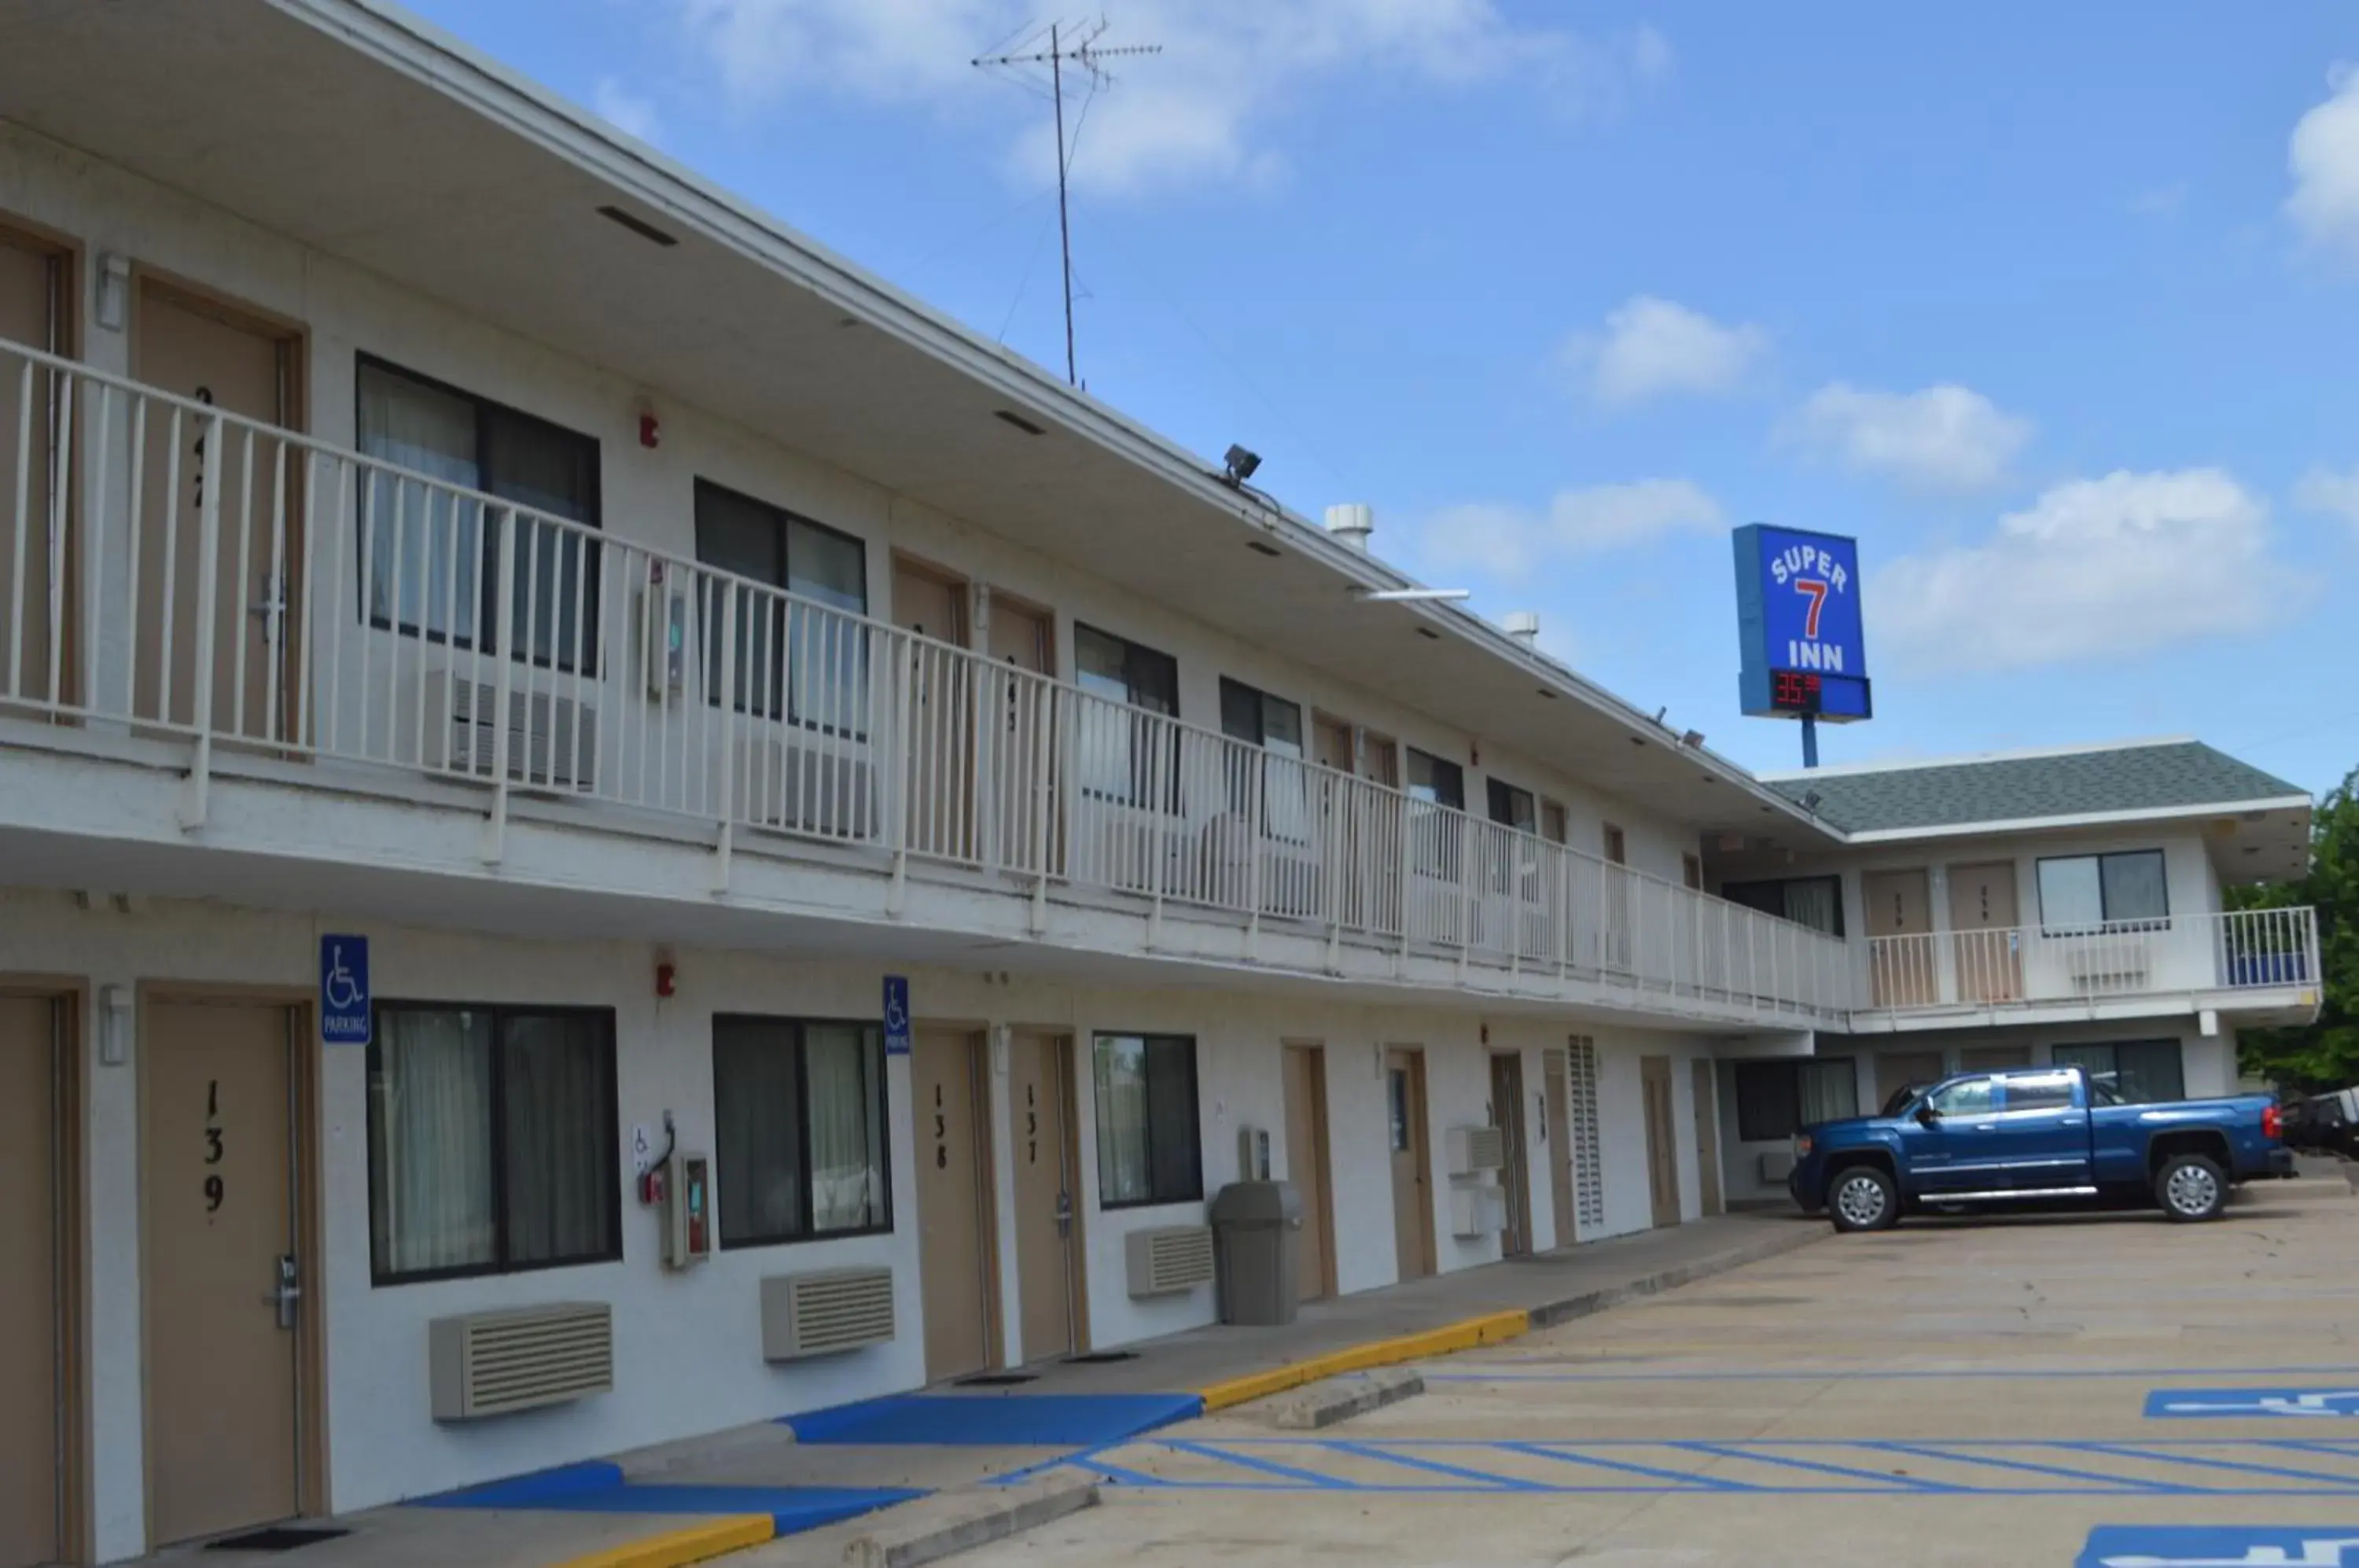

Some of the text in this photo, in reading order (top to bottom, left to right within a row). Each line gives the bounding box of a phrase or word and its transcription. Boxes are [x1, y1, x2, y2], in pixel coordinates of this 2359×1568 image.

[1771, 545, 1847, 594] SUPER
[1794, 577, 1828, 640] 7
[1789, 639, 1843, 672] INN
[324, 1014, 367, 1036] PARKING
[204, 1078, 224, 1214] 139
[1026, 1084, 1037, 1166] 137
